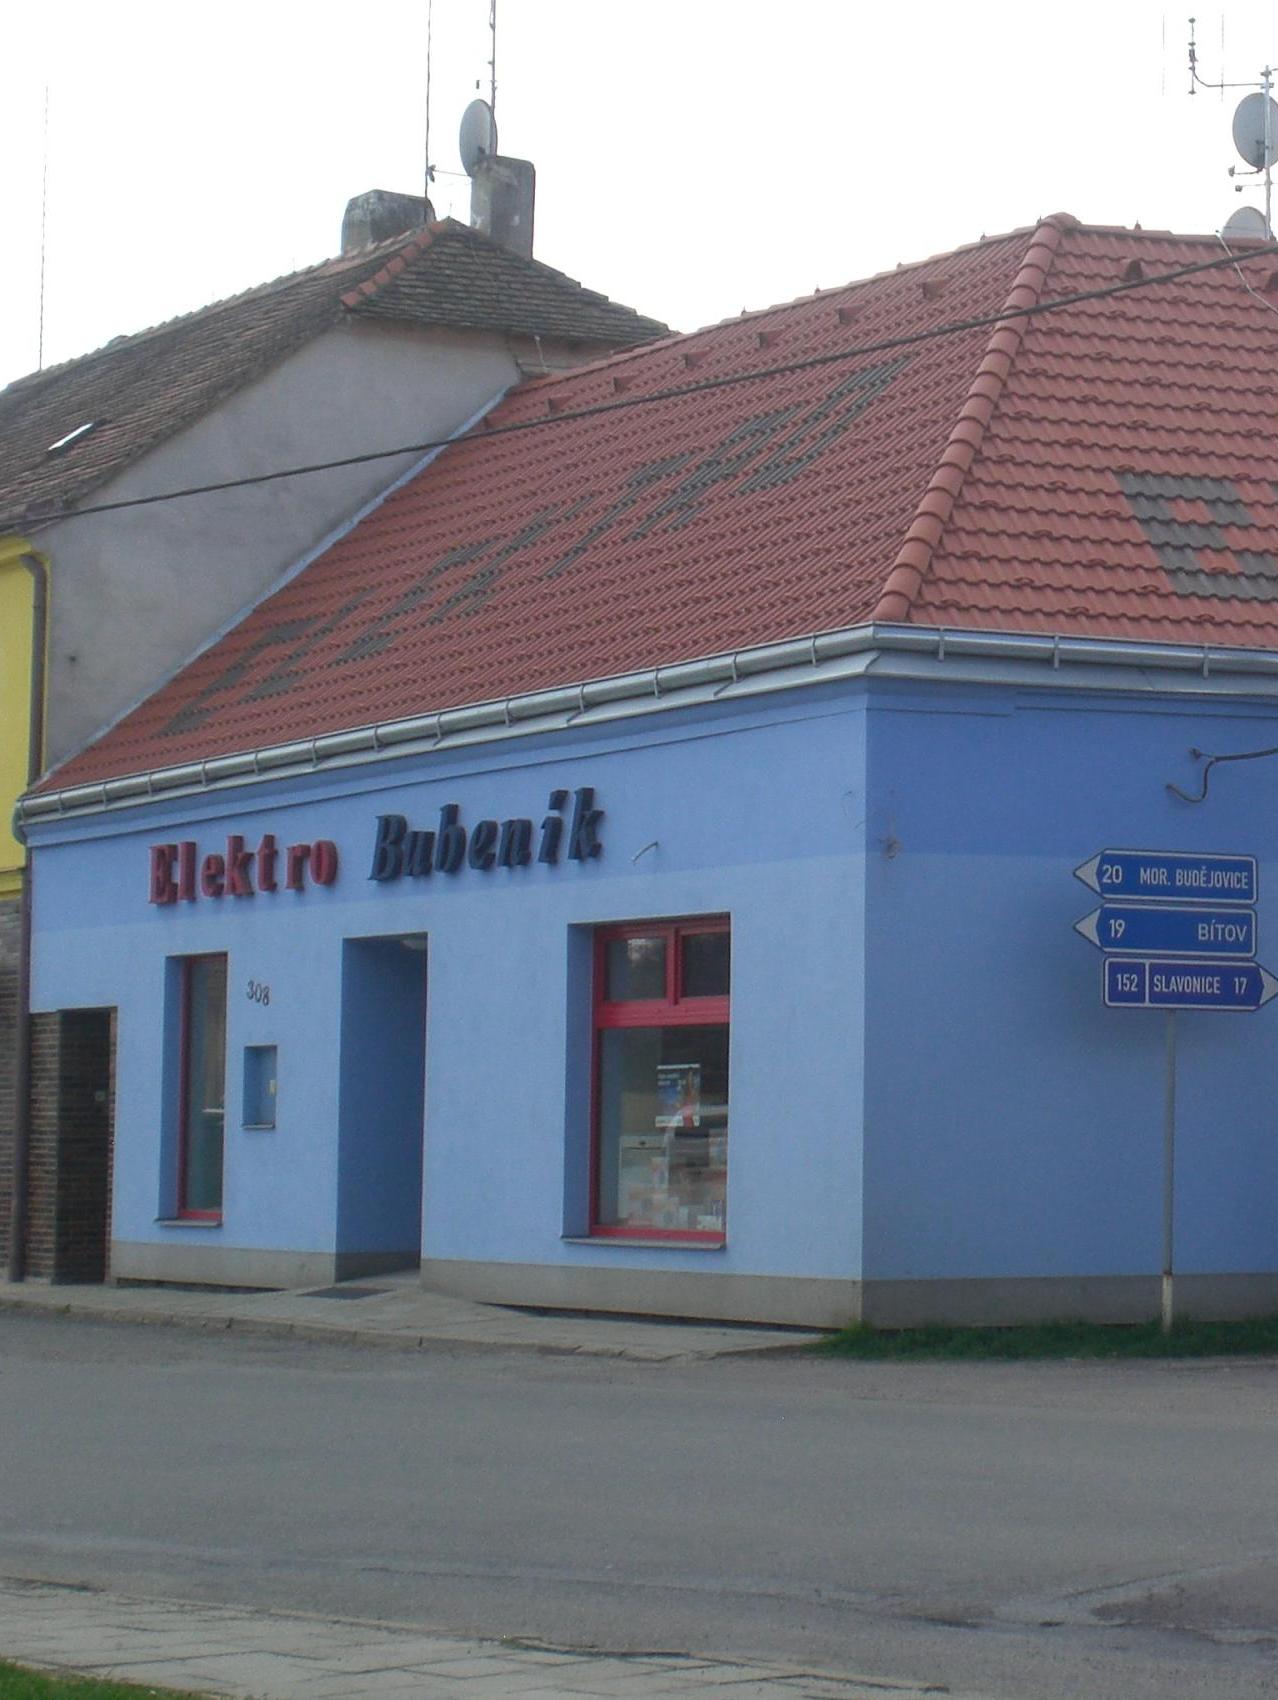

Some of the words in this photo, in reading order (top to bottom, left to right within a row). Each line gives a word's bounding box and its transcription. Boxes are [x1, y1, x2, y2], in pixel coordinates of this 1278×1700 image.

[148, 834, 339, 905] Elektro
[1102, 865, 1123, 884] 20
[1140, 867, 1171, 886] MOR.
[1176, 866, 1249, 889] BUDĚJOVICE
[1109, 919, 1126, 938] 19
[1198, 919, 1248, 941] BÍTOV
[246, 979, 270, 1007] 308
[1116, 974, 1138, 993] 152
[1153, 976, 1221, 994] SLAVONICE
[1234, 977, 1247, 995] 17
